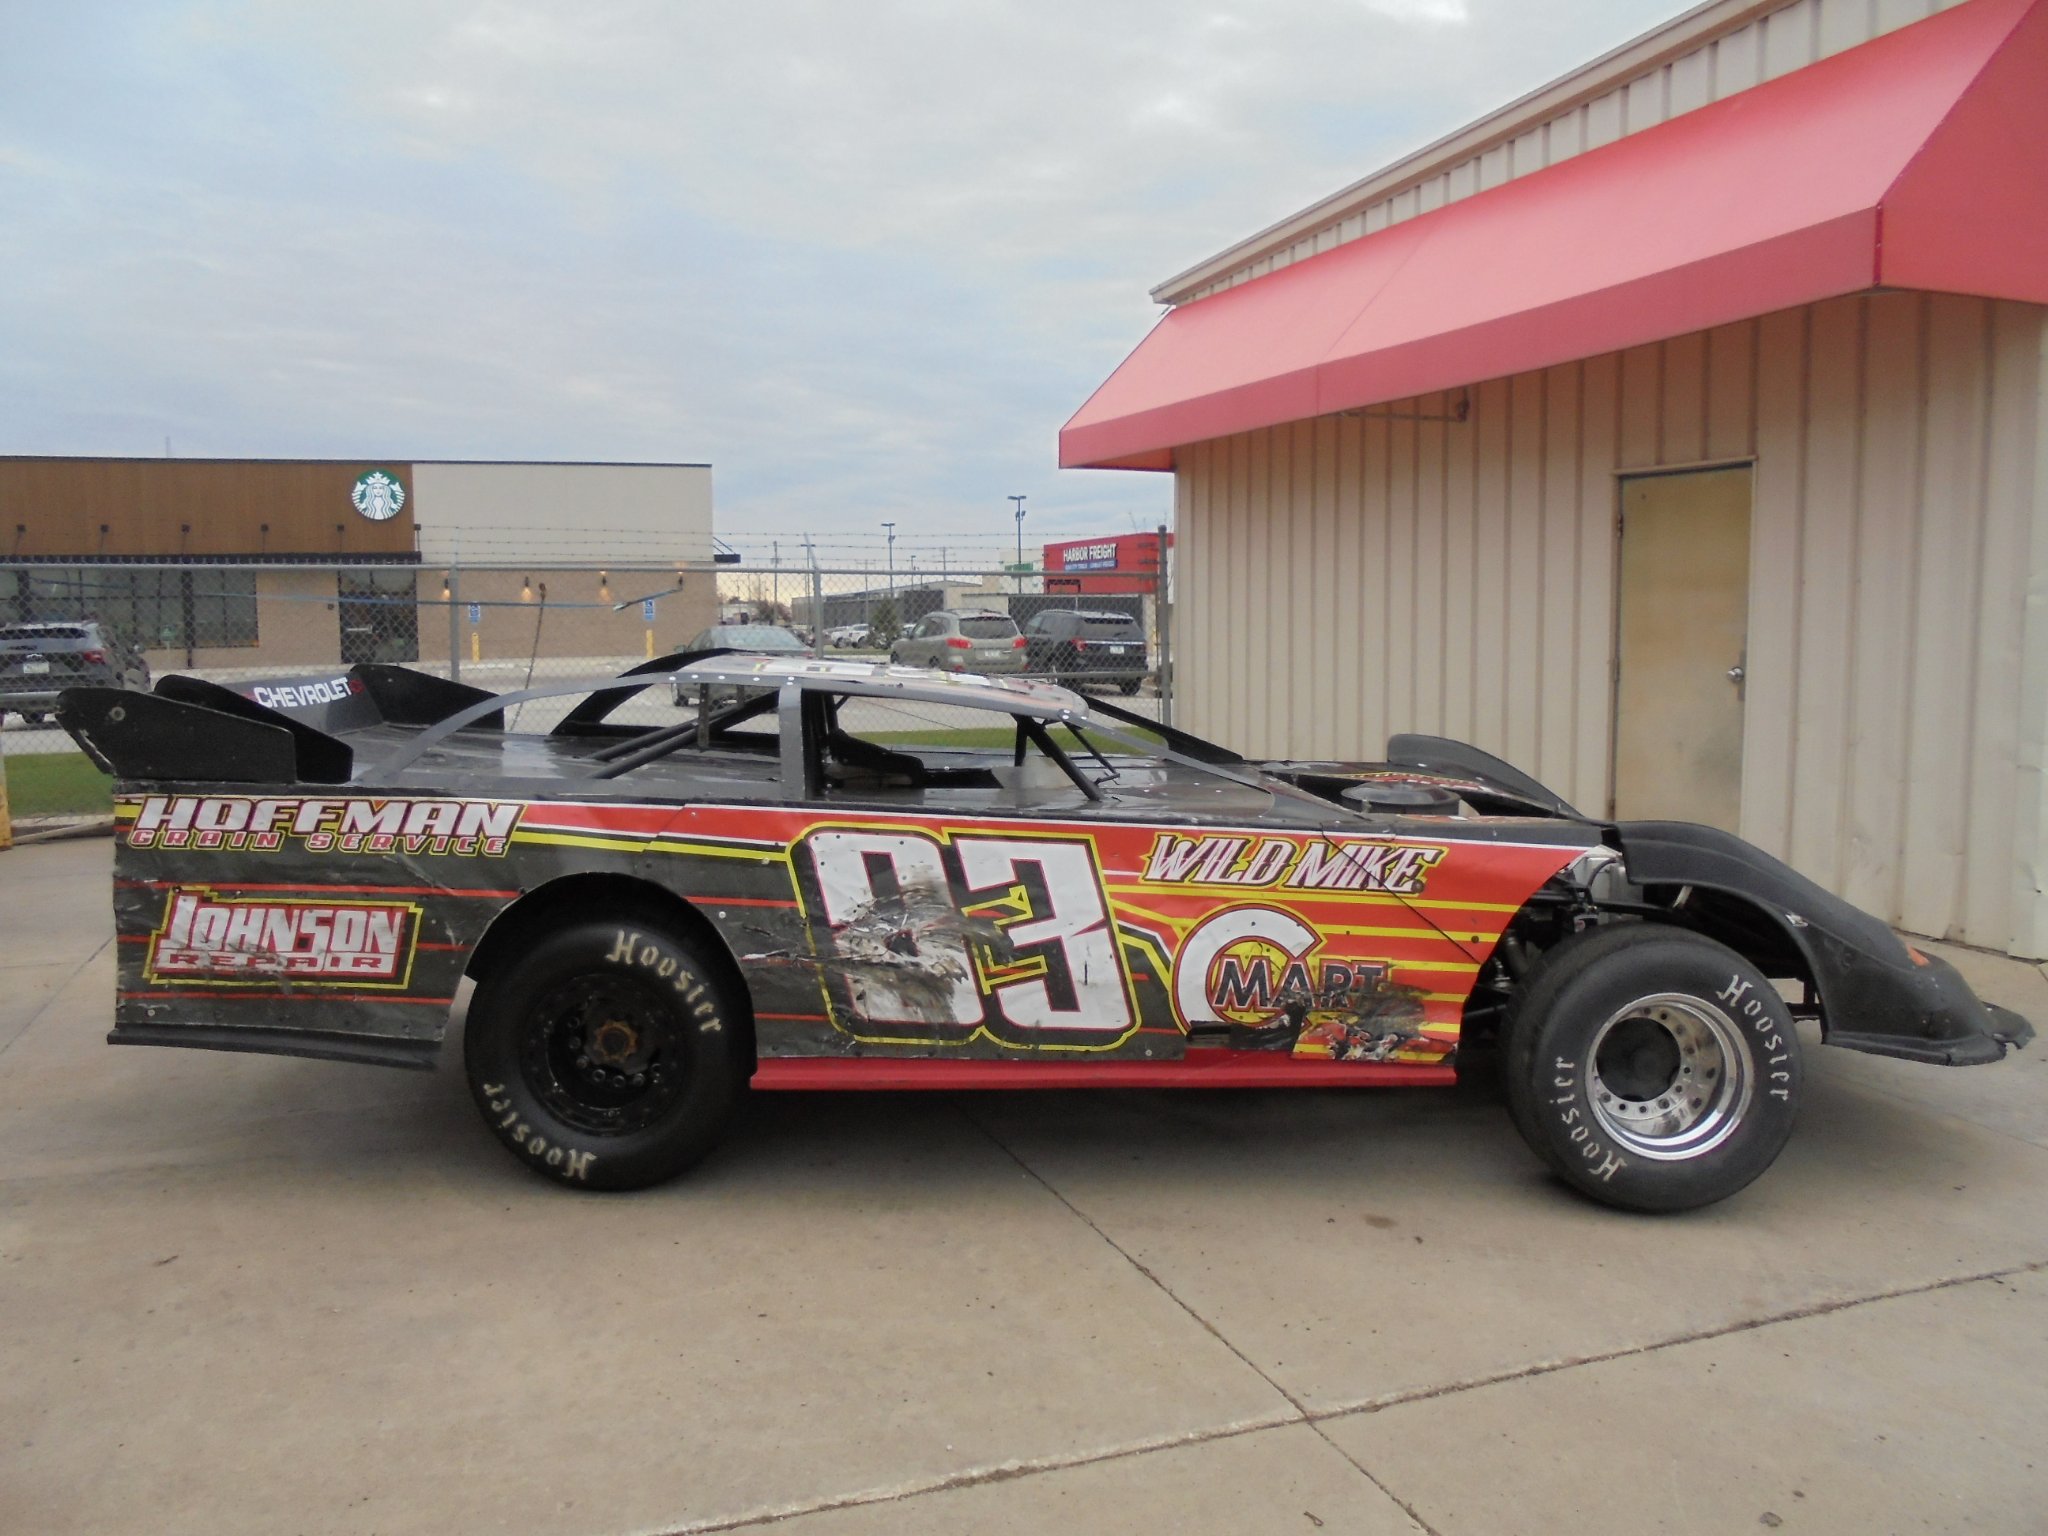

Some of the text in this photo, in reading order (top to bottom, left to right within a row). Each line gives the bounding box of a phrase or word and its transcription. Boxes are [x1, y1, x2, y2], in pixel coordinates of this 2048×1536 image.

[1063, 543, 1117, 562] HARBOR FREIGHT
[253, 676, 352, 708] CHEVROLET
[130, 829, 511, 855] GRAIN SERVICE
[137, 797, 525, 838] HOFFMAN
[1144, 833, 1444, 893] WILD MIKE
[157, 894, 402, 954] JOHNSON
[168, 953, 382, 970] REPAIR
[607, 929, 722, 1032] Hoosier
[1213, 957, 1388, 1010] MART
[1716, 974, 1793, 1101] Hoosier
[1550, 1056, 1627, 1182] Hoosier
